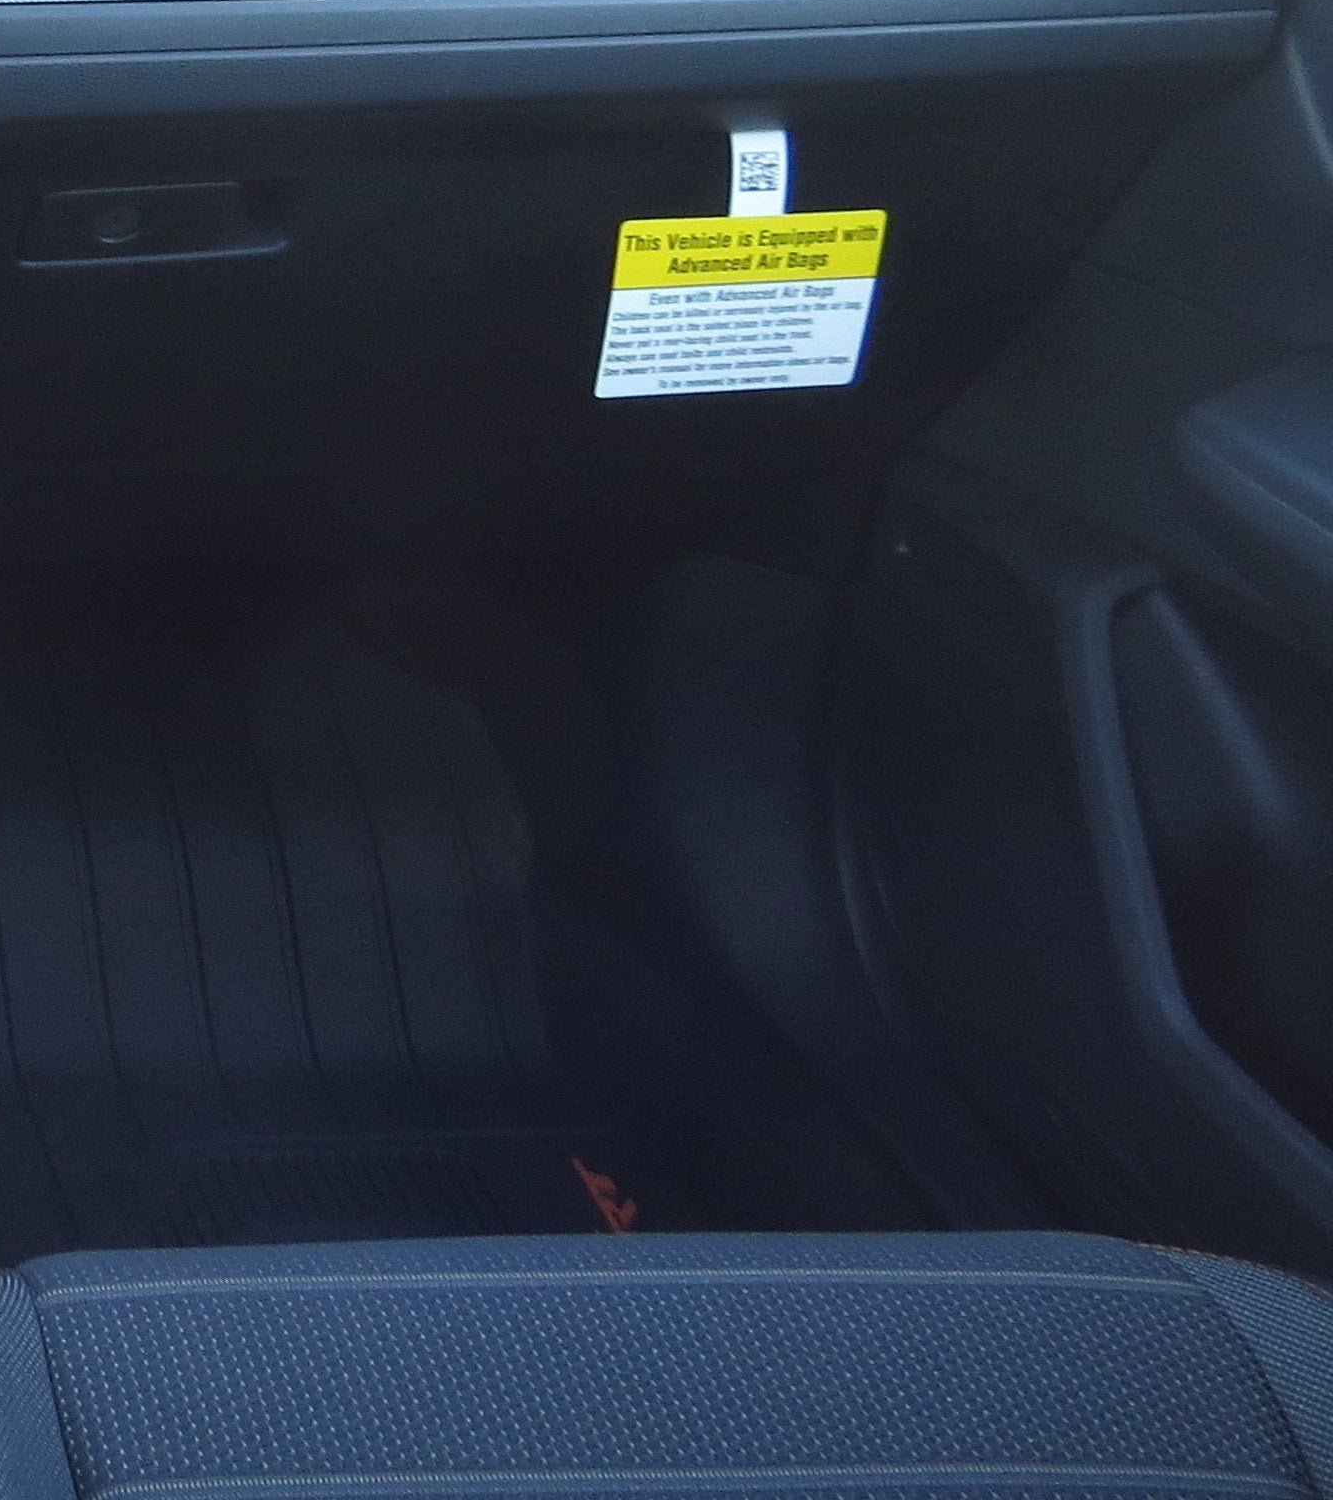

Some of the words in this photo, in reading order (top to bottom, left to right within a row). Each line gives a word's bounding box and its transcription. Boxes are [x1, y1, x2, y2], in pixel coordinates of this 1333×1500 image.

[625, 234, 661, 252] This
[667, 232, 733, 251] Vehicle
[738, 231, 754, 248] is
[758, 227, 838, 249] Equipped
[843, 224, 880, 242] with
[666, 254, 752, 274] Advanced
[755, 253, 783, 270] Air
[785, 251, 830, 271] Bags
